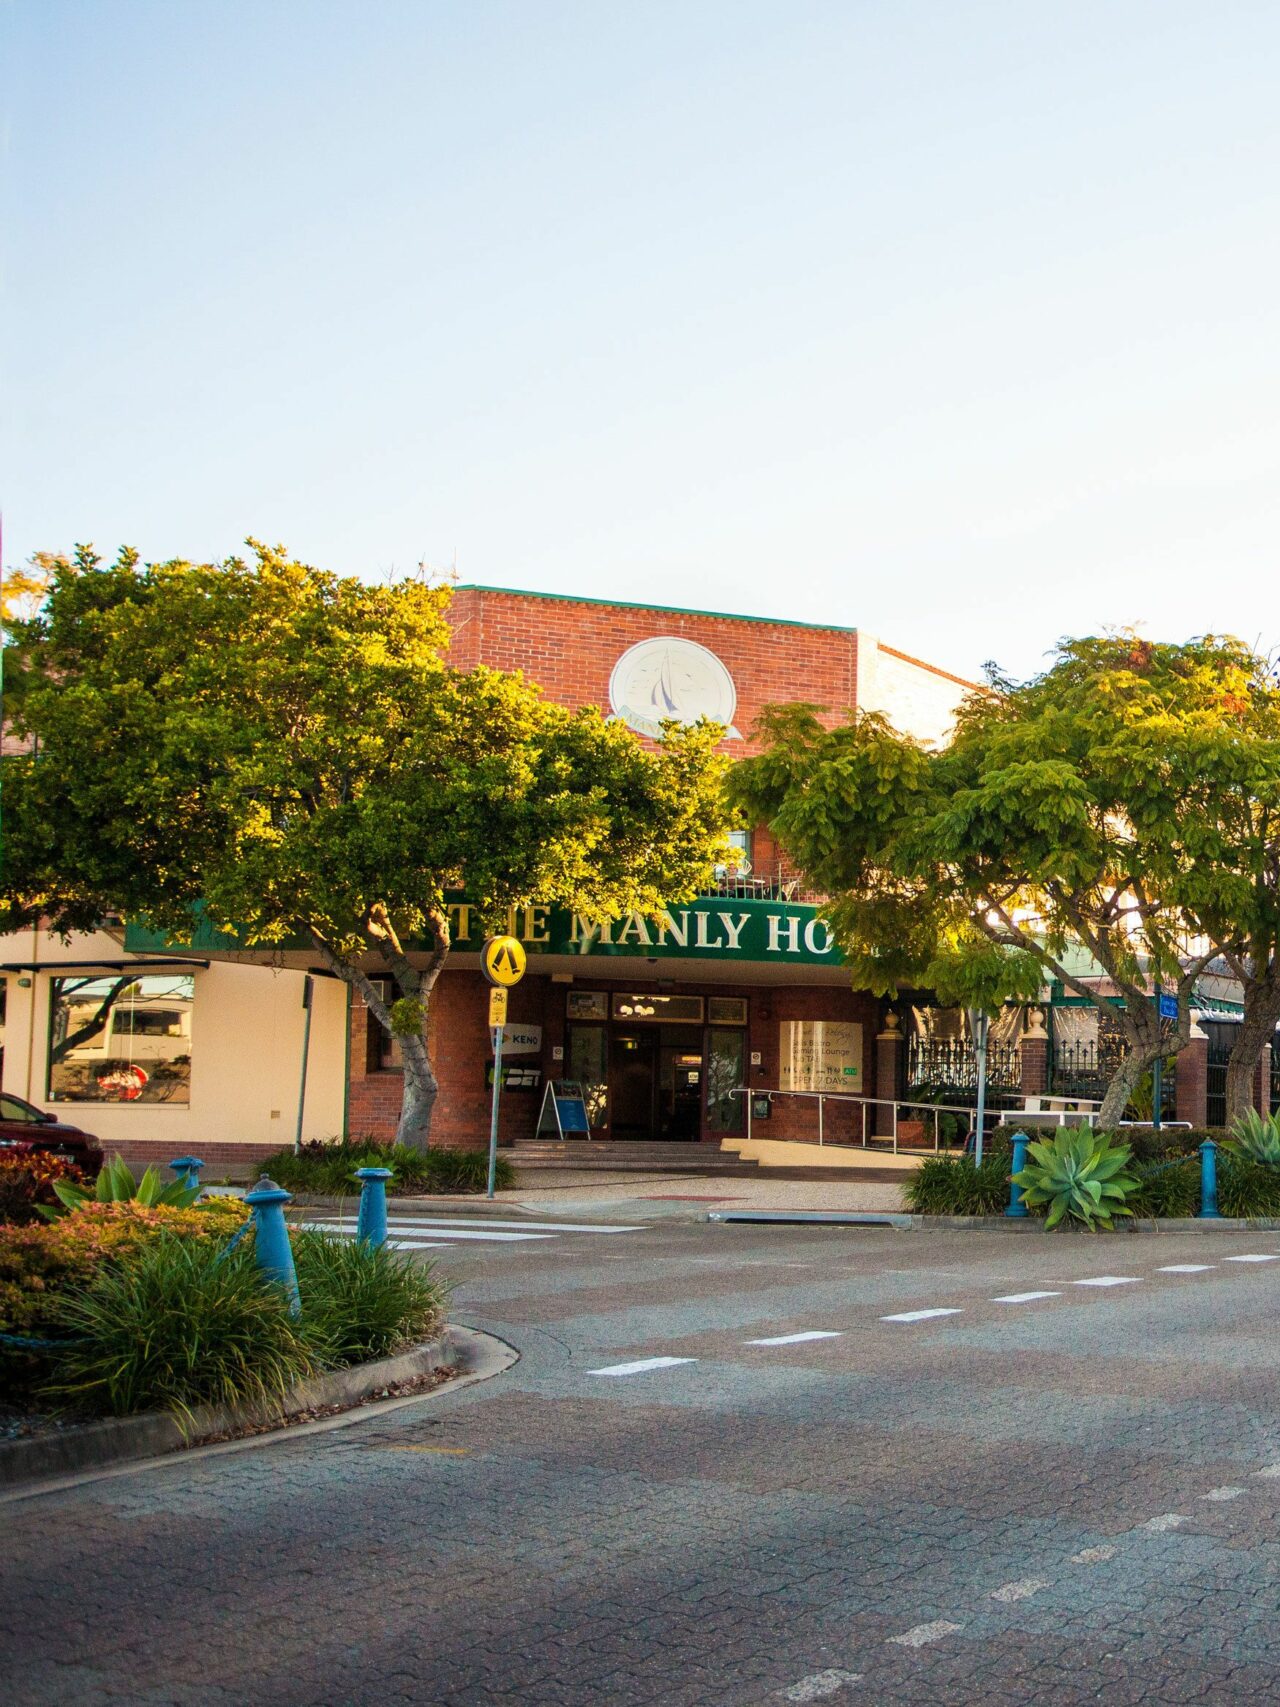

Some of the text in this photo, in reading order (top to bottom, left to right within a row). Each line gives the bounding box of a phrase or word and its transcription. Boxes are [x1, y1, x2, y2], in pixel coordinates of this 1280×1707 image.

[568, 909, 753, 949] MANLY
[513, 1035, 538, 1045] KENO
[822, 1047, 850, 1056] Lounge
[825, 1077, 848, 1085] DAYS
